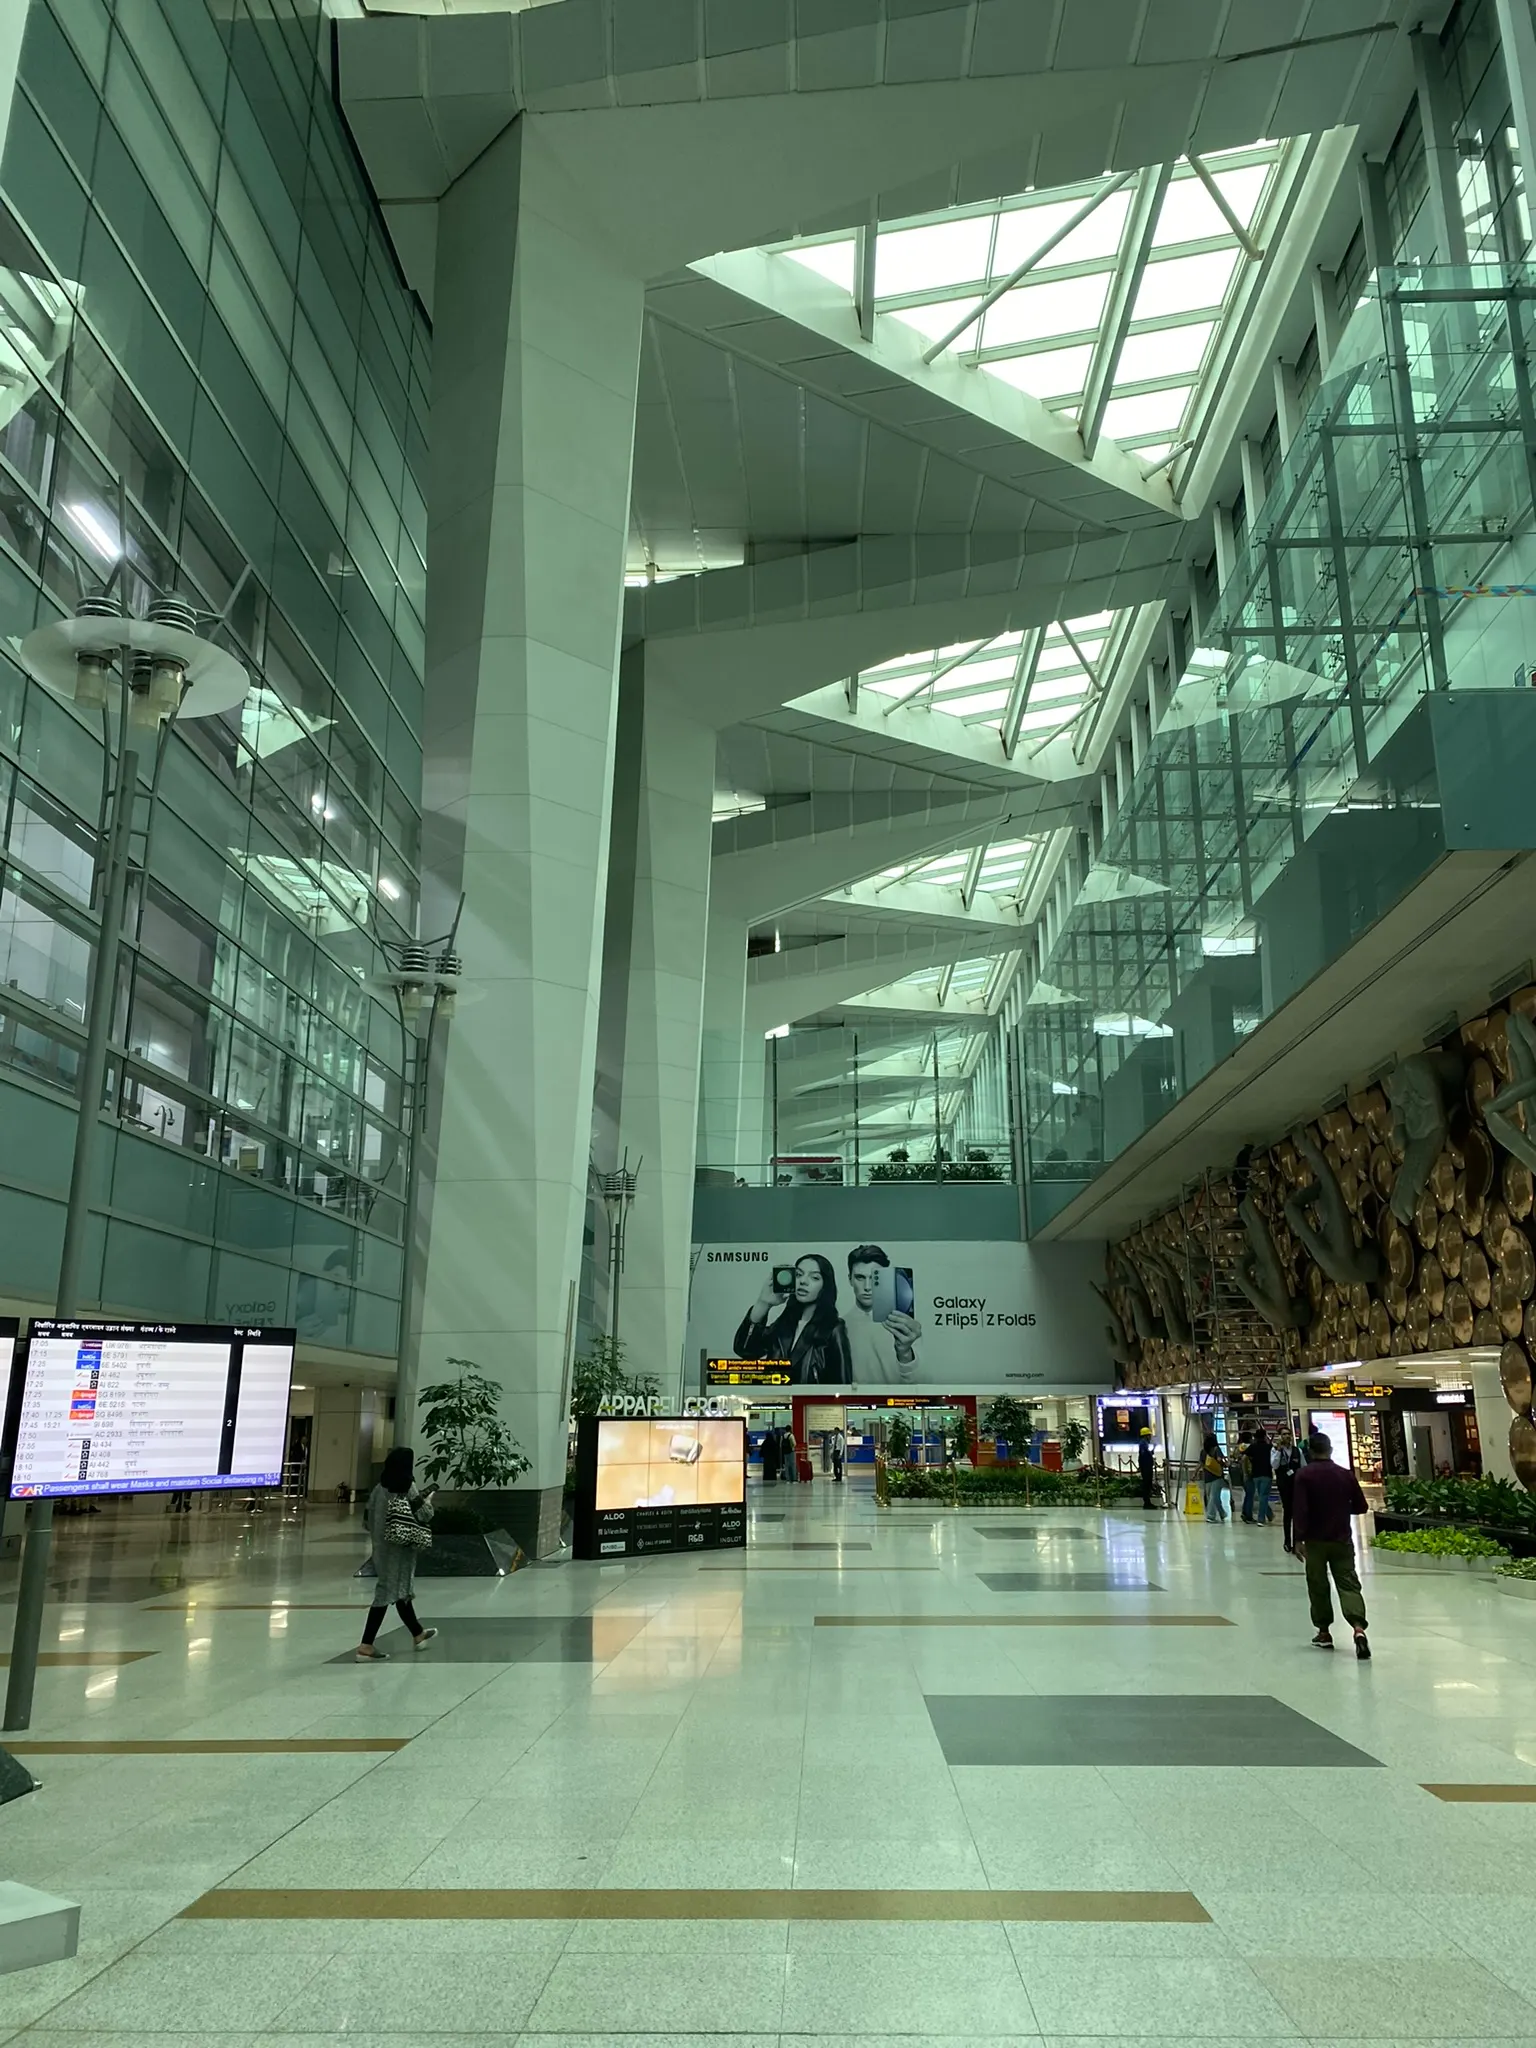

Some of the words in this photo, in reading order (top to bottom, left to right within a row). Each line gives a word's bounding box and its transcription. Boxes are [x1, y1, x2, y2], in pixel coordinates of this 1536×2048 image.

[707, 1252, 769, 1262] SAMSUNG
[933, 1296, 986, 1312] Galaxy
[935, 1313, 943, 1326] Z
[946, 1313, 979, 1330] Flip5
[986, 1313, 995, 1326] Z
[998, 1313, 1036, 1326] Fold5
[596, 1395, 680, 1416] APPAREL
[226, 1419, 232, 1427] 2
[44, 1483, 89, 1493] Passengers
[130, 1480, 154, 1489] Masks
[155, 1479, 169, 1487] and
[201, 1476, 223, 1485] Social
[722, 1520, 741, 1528] ALDO
[688, 1534, 704, 1543] R&B
